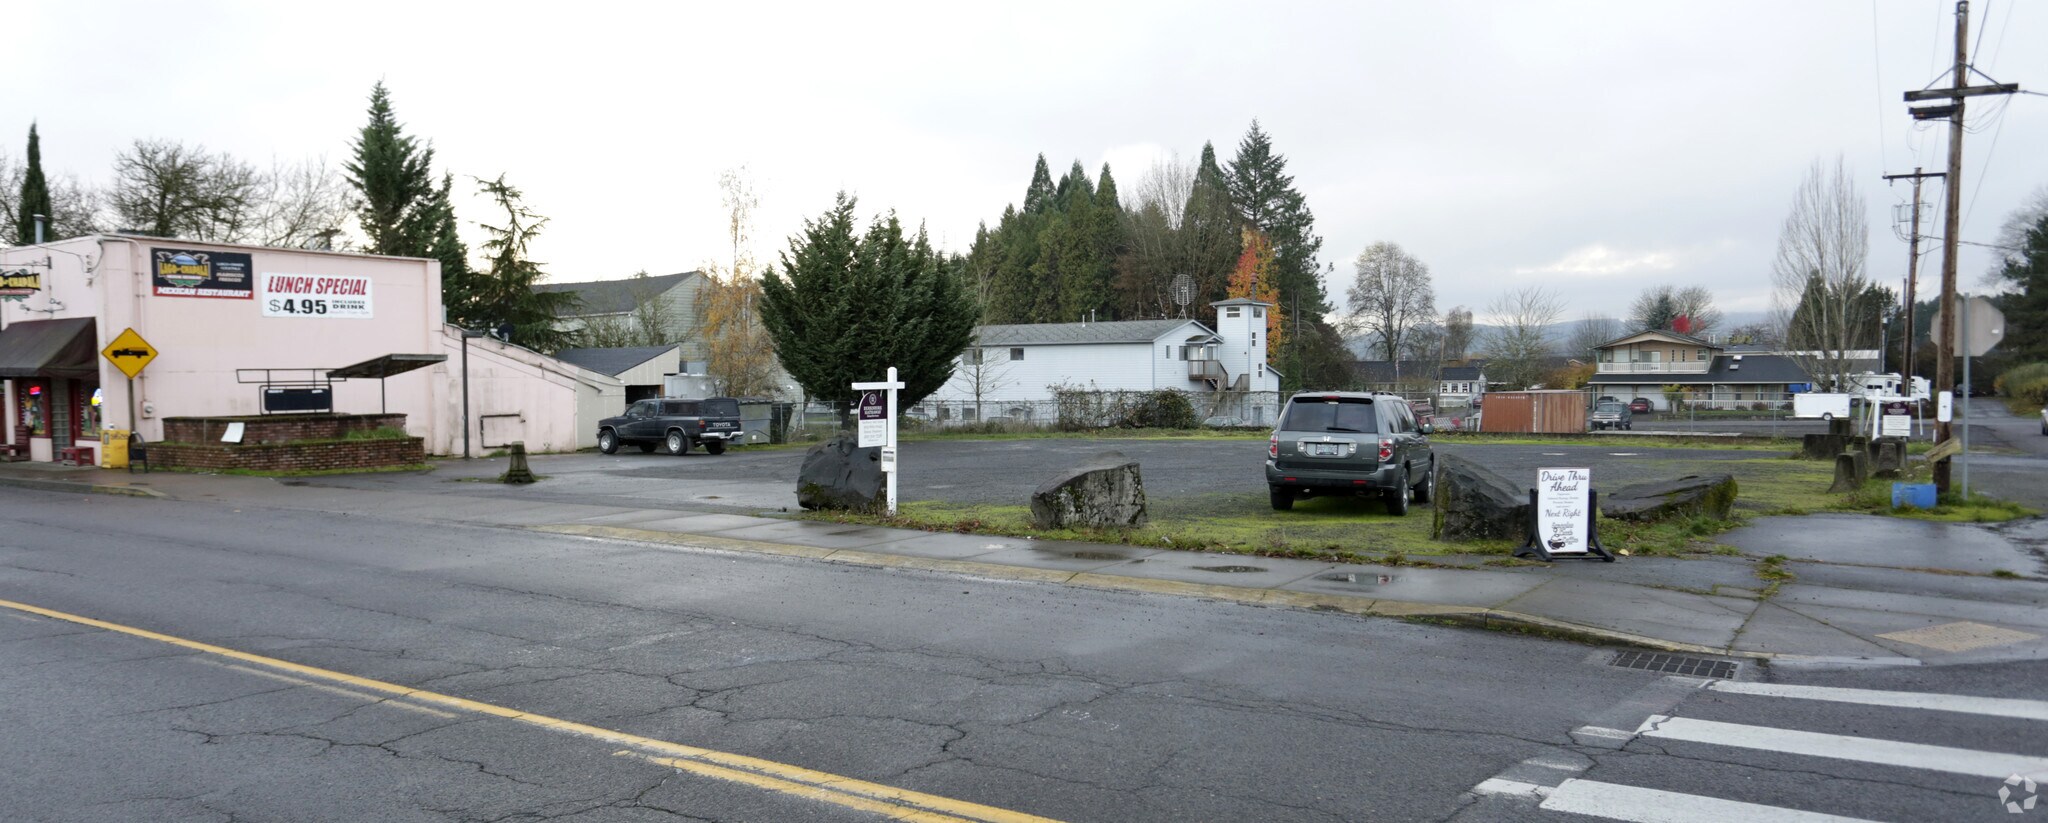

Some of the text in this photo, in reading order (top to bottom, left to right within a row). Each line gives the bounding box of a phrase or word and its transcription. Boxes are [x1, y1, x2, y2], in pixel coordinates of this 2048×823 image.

[268, 276, 367, 295] LUNCH SPECIAL
[157, 287, 251, 297] MEXICAN RESTAURANT
[269, 299, 327, 315] $4.95
[1541, 470, 1588, 482] Drive Thru
[1550, 481, 1578, 492] Ahead
[1545, 508, 1582, 520] Next Right
